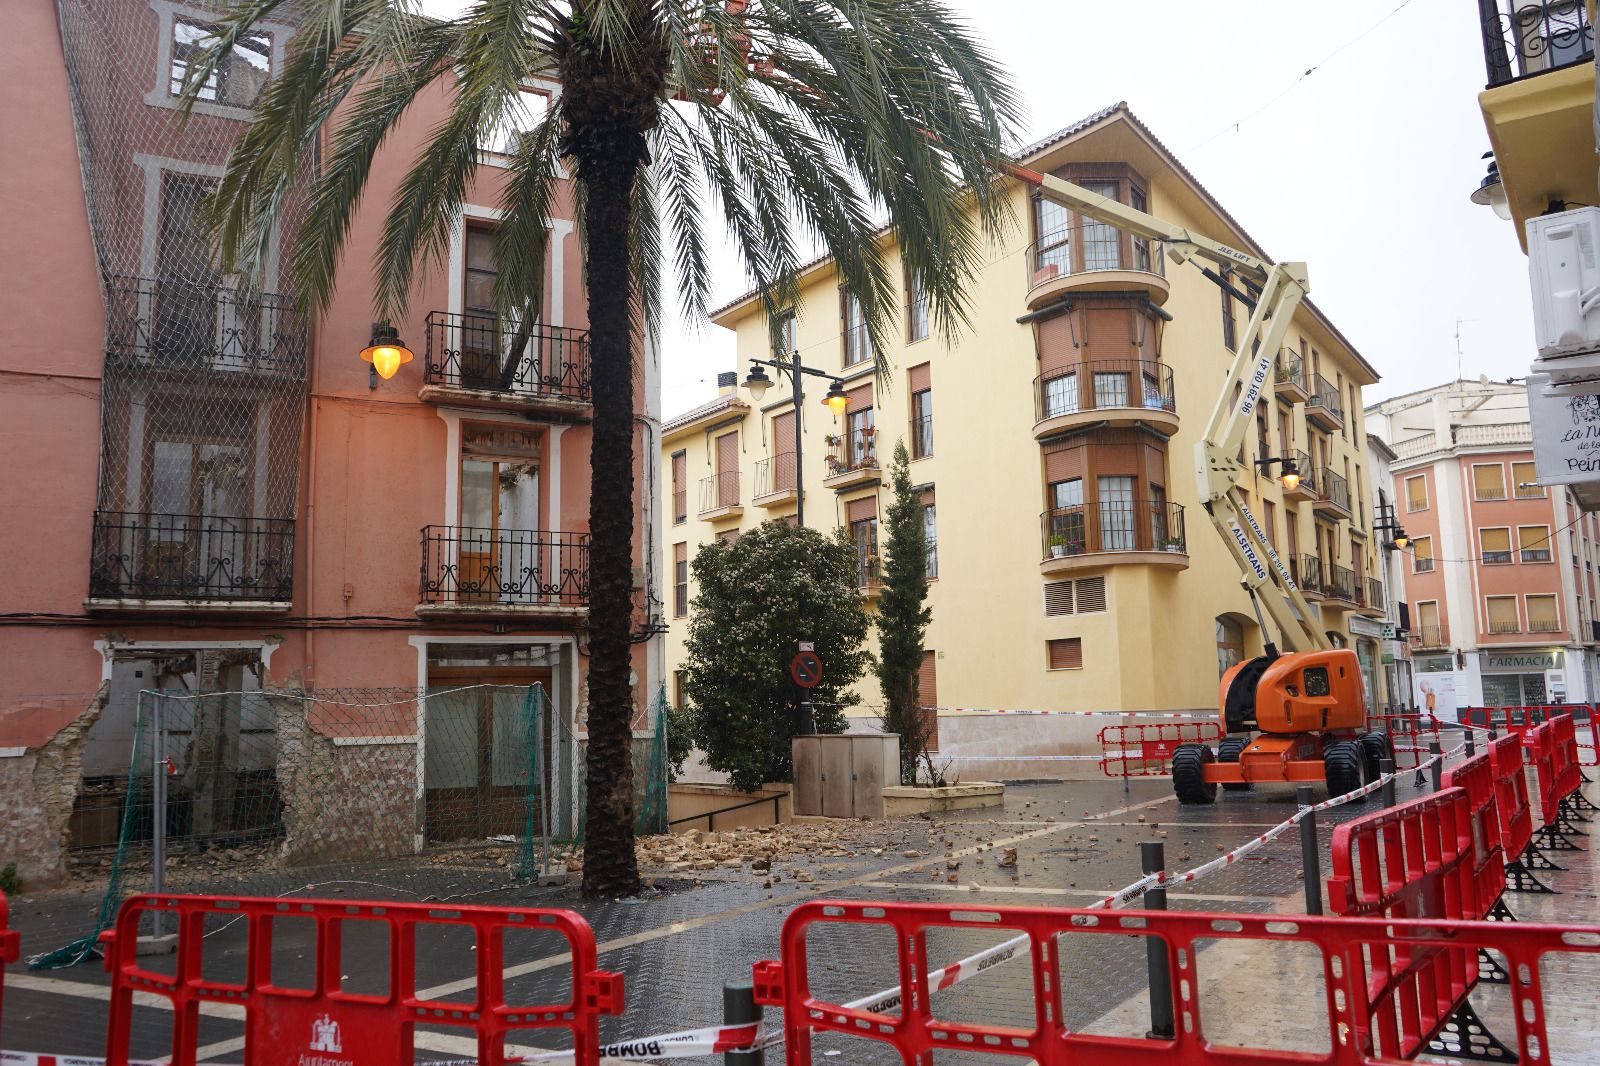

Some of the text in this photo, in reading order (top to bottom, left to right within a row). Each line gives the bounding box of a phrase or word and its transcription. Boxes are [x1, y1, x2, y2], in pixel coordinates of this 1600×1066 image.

[1218, 246, 1251, 262] JLG LIFT
[1241, 358, 1270, 414] 96 291 08 41
[1560, 429, 1584, 443] La
[1241, 507, 1268, 545] ALSETRANS
[1231, 527, 1267, 580] ALSETRANS
[1273, 558, 1285, 572] 291
[1282, 571, 1290, 581] 08
[1288, 580, 1296, 590] 41
[1488, 656, 1555, 667] FARMACIA
[598, 1040, 661, 1058] BOMBE
